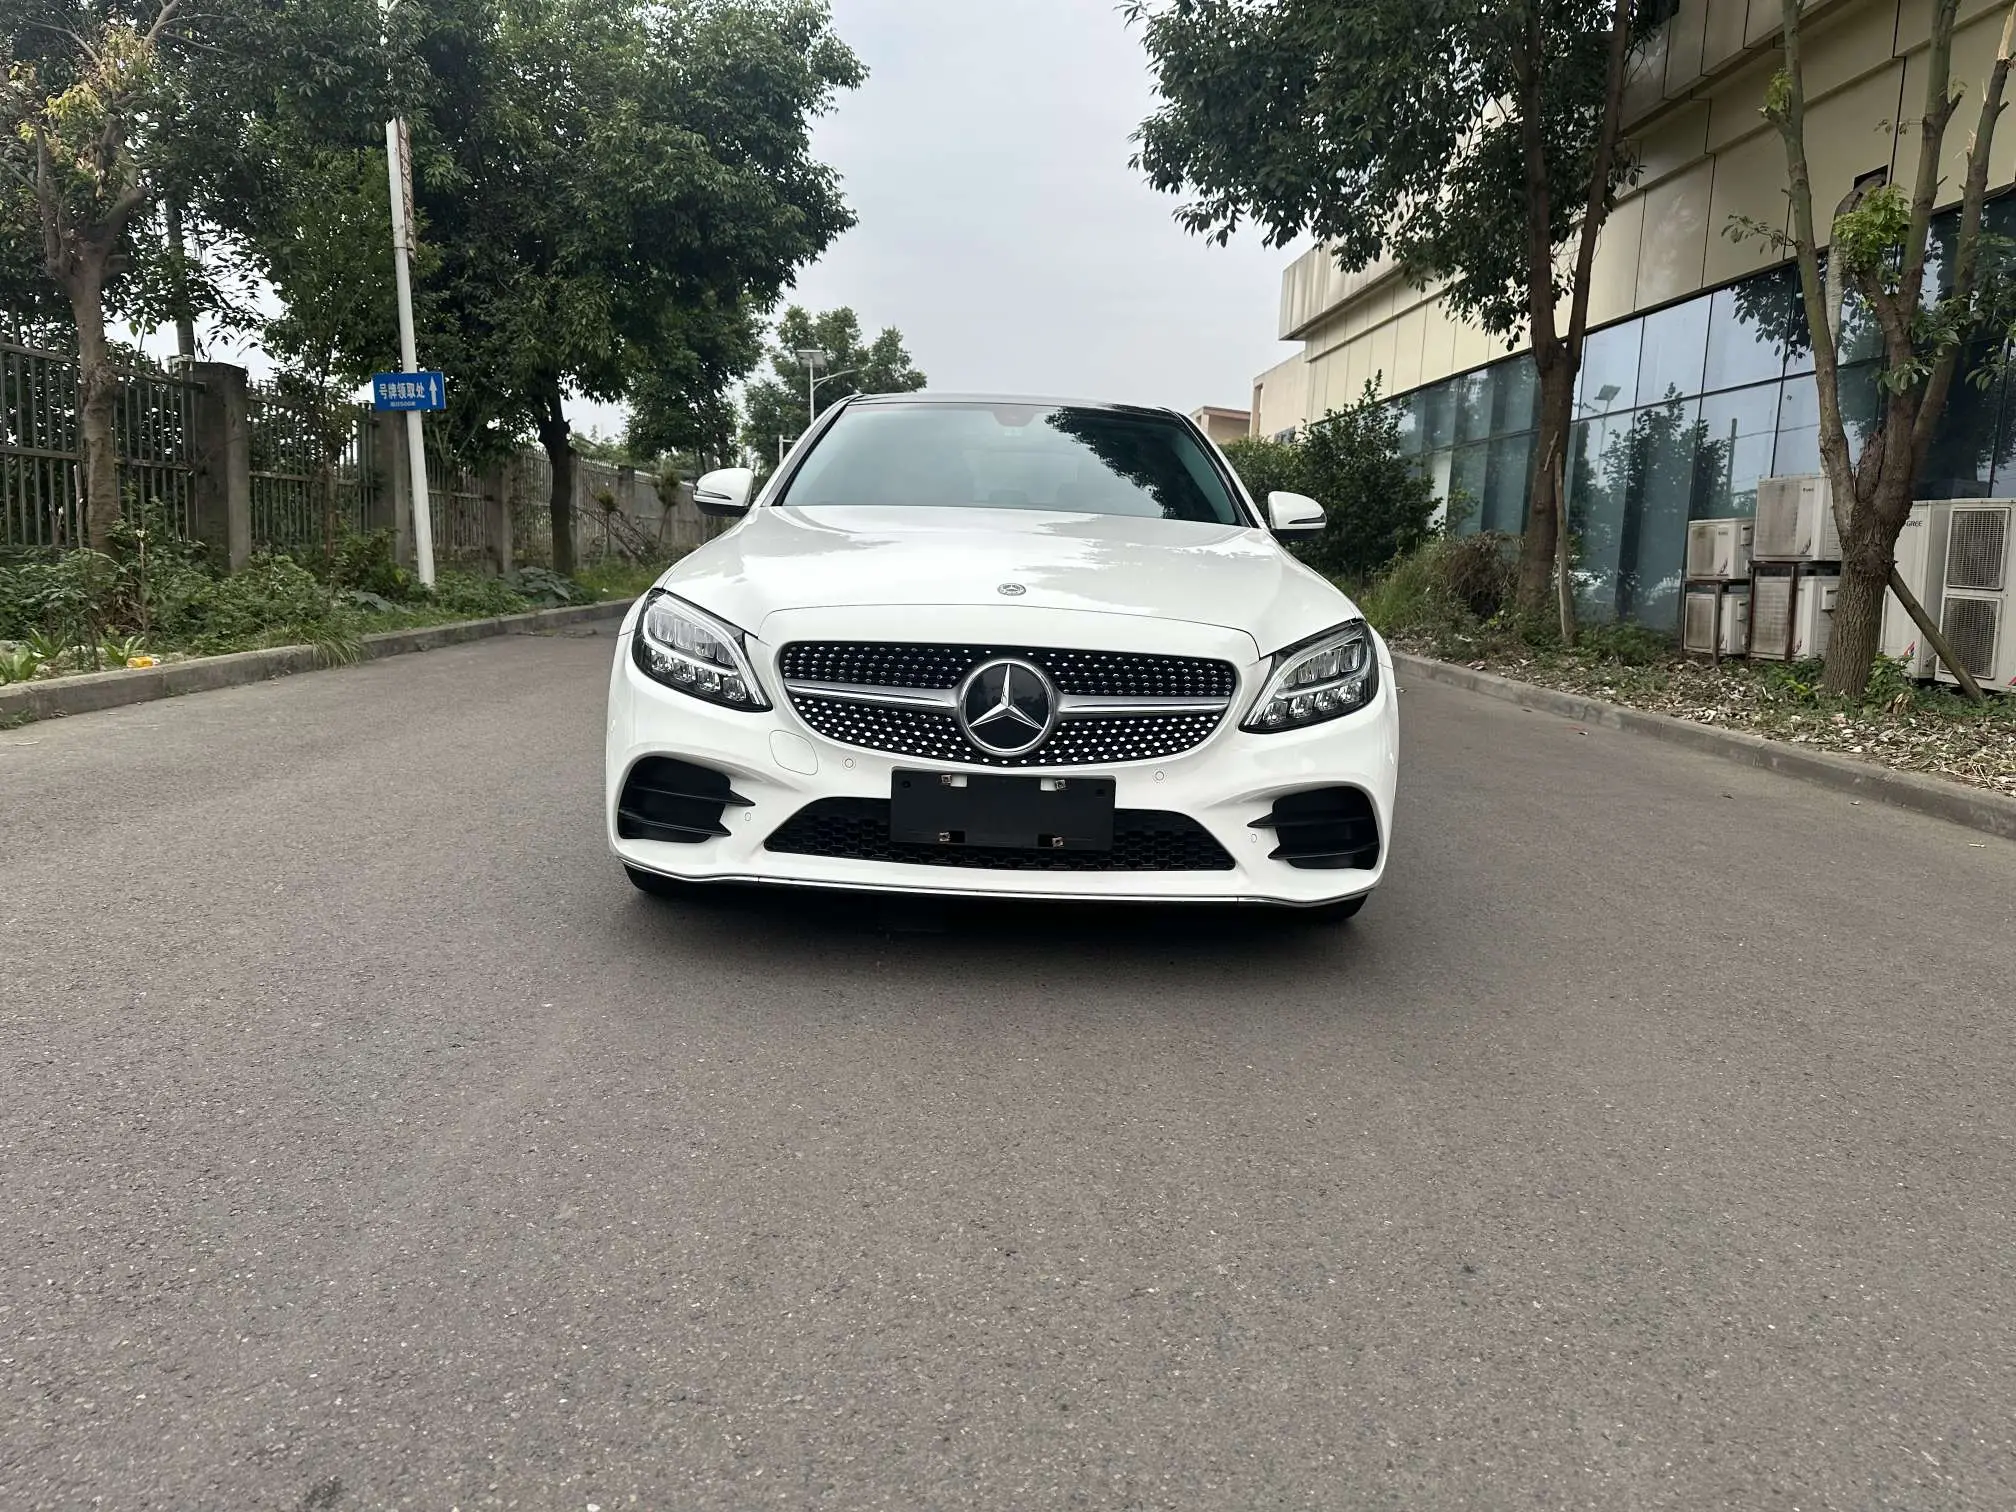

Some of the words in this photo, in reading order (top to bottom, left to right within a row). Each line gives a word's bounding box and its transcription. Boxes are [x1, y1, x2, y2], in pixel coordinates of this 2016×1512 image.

[379, 382, 425, 400] 号牌领取处
